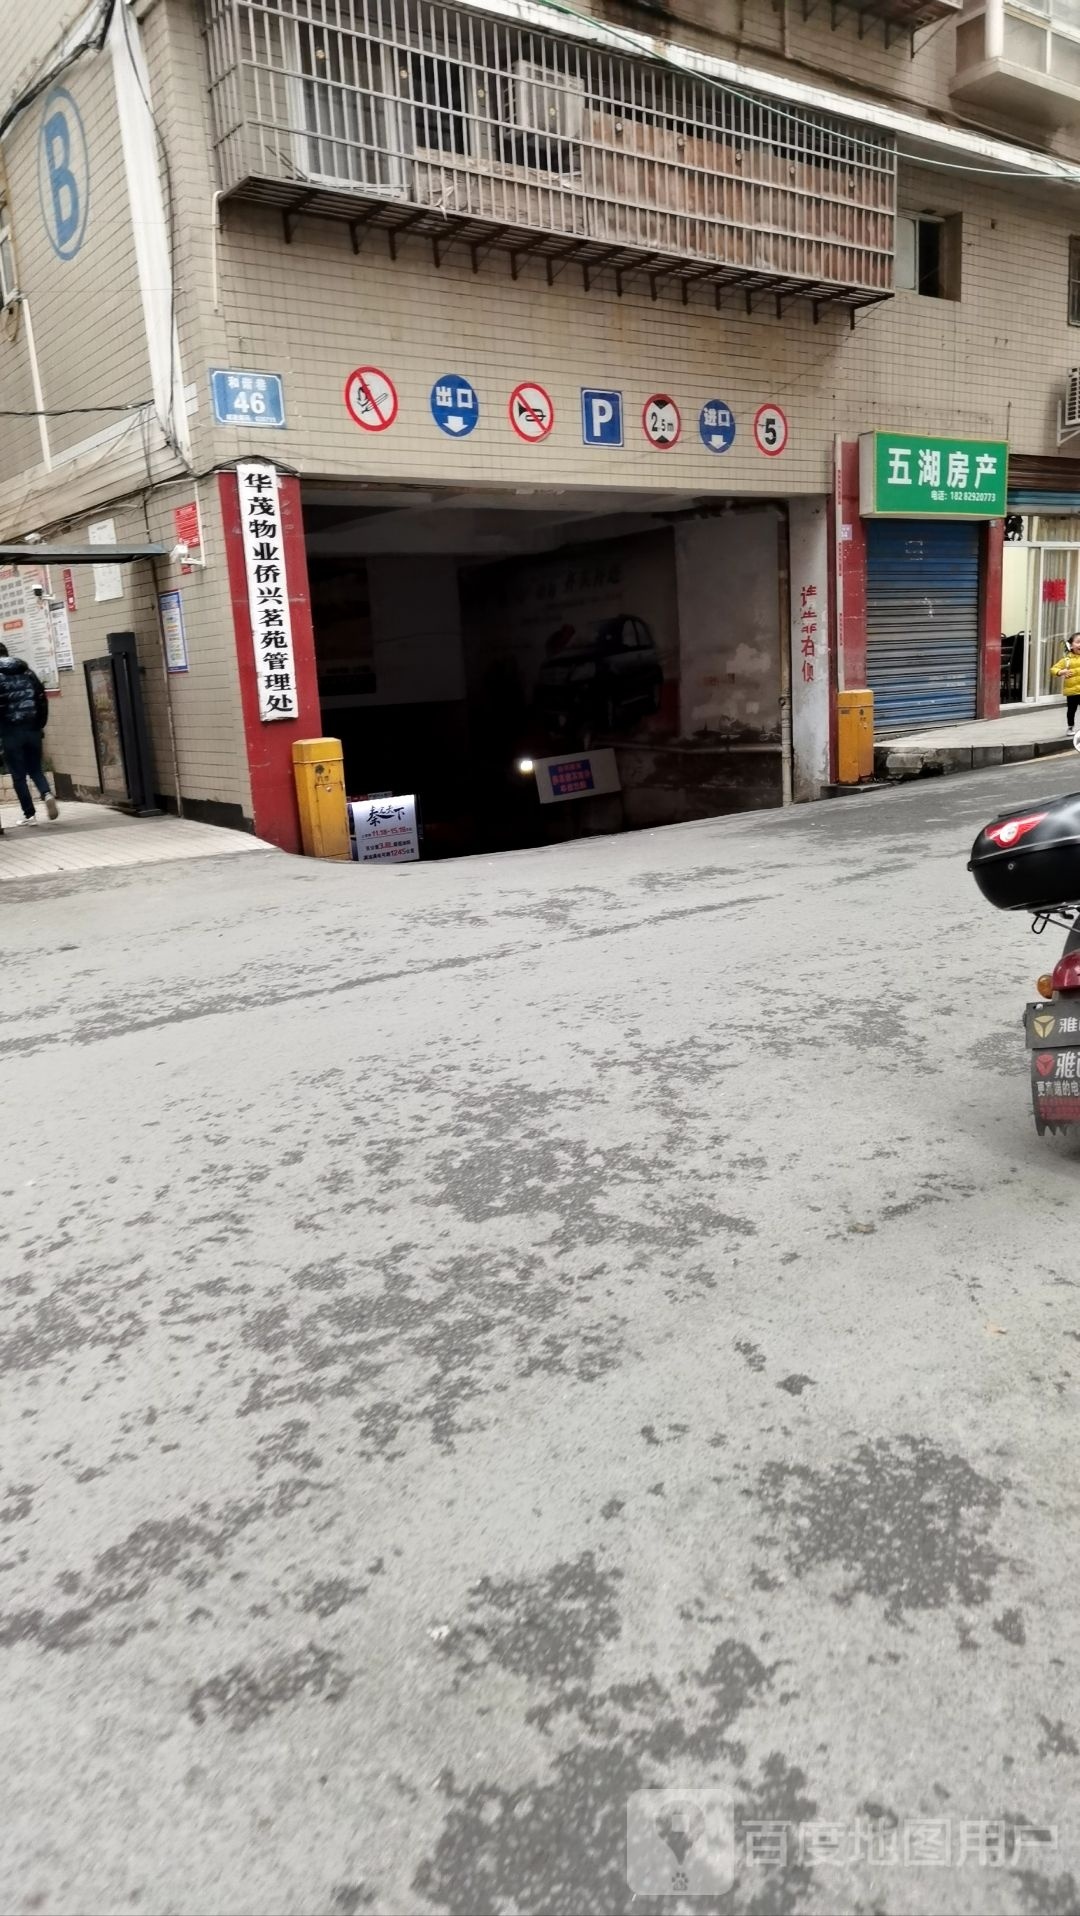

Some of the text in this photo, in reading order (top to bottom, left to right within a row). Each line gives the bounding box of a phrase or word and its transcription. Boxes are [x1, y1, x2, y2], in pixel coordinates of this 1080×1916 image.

[45, 111, 80, 249] B
[233, 391, 266, 414] 46
[435, 385, 473, 409] 出口
[591, 399, 613, 437] P
[703, 407, 731, 428] 进口
[764, 418, 777, 445] 5
[887, 447, 998, 489] 五湖房产
[244, 472, 294, 713] 华茂物业侨兴茗苑管理处
[1059, 1016, 1080, 1033] 雅
[1055, 1050, 1080, 1079] 雅
